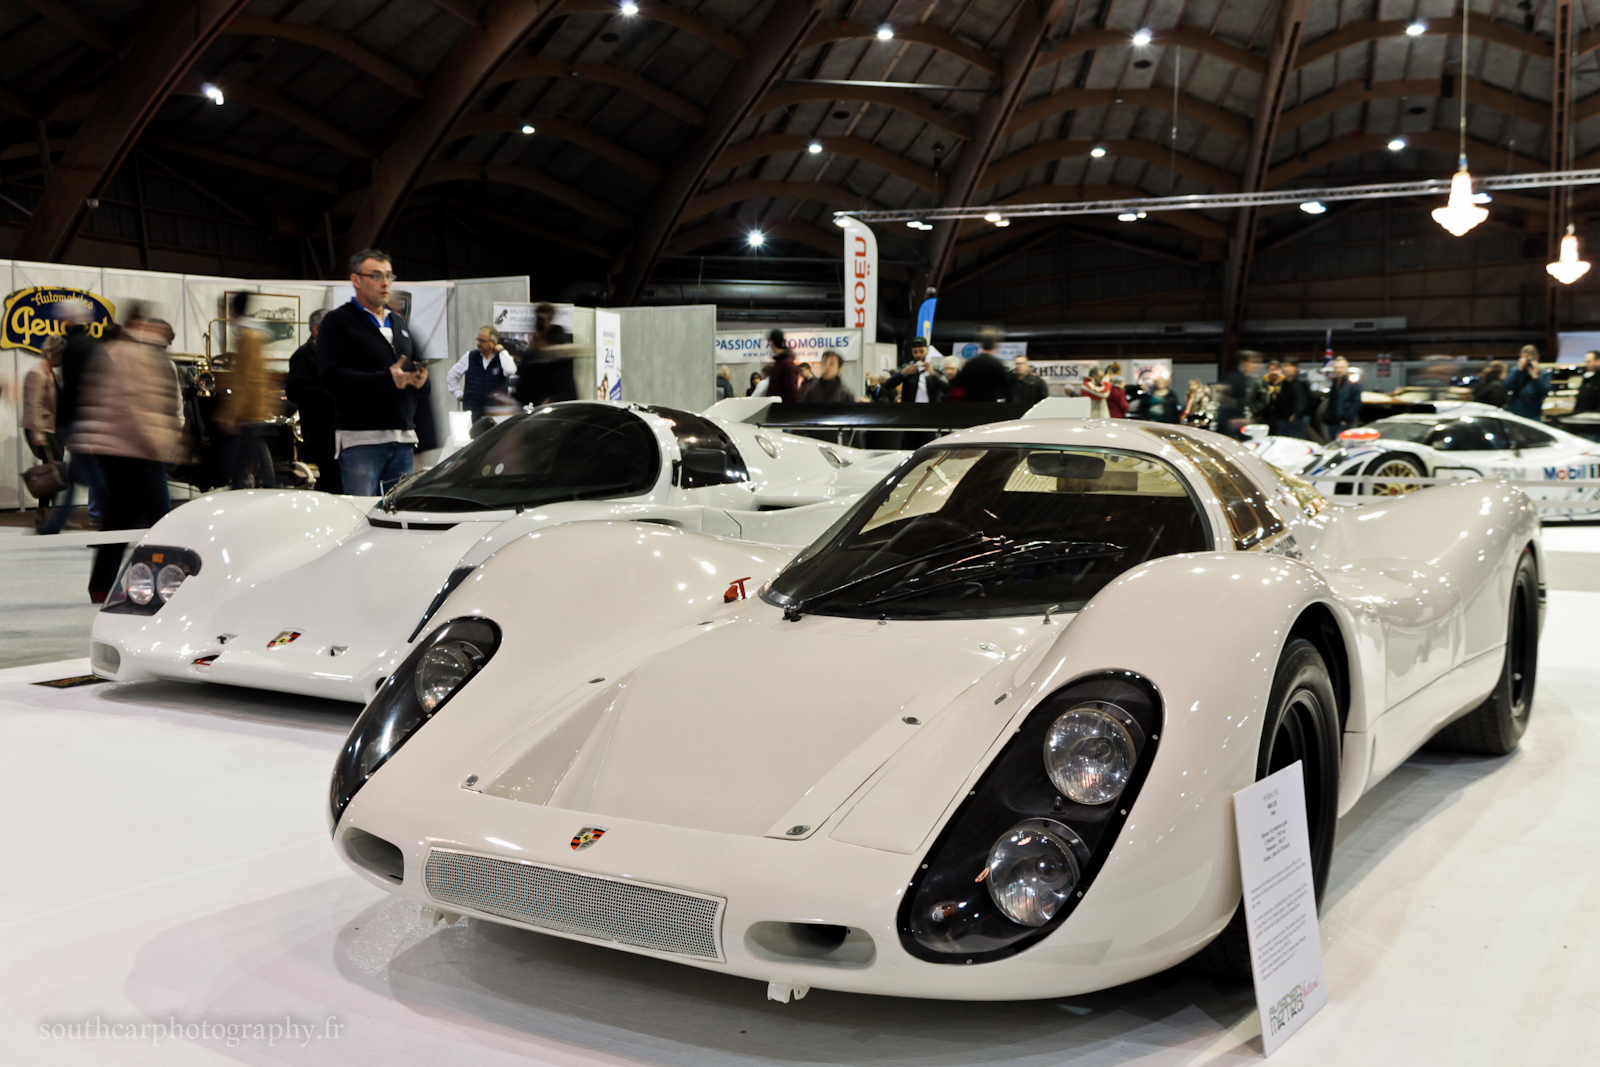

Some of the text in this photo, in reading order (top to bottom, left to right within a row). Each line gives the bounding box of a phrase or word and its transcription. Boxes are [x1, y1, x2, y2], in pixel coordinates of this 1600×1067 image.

[31, 291, 94, 310] Automobiles
[716, 336, 849, 350] PASSION AOMOBILES
[1035, 365, 1079, 377] HKISS
[1543, 465, 1587, 480] Mobil
